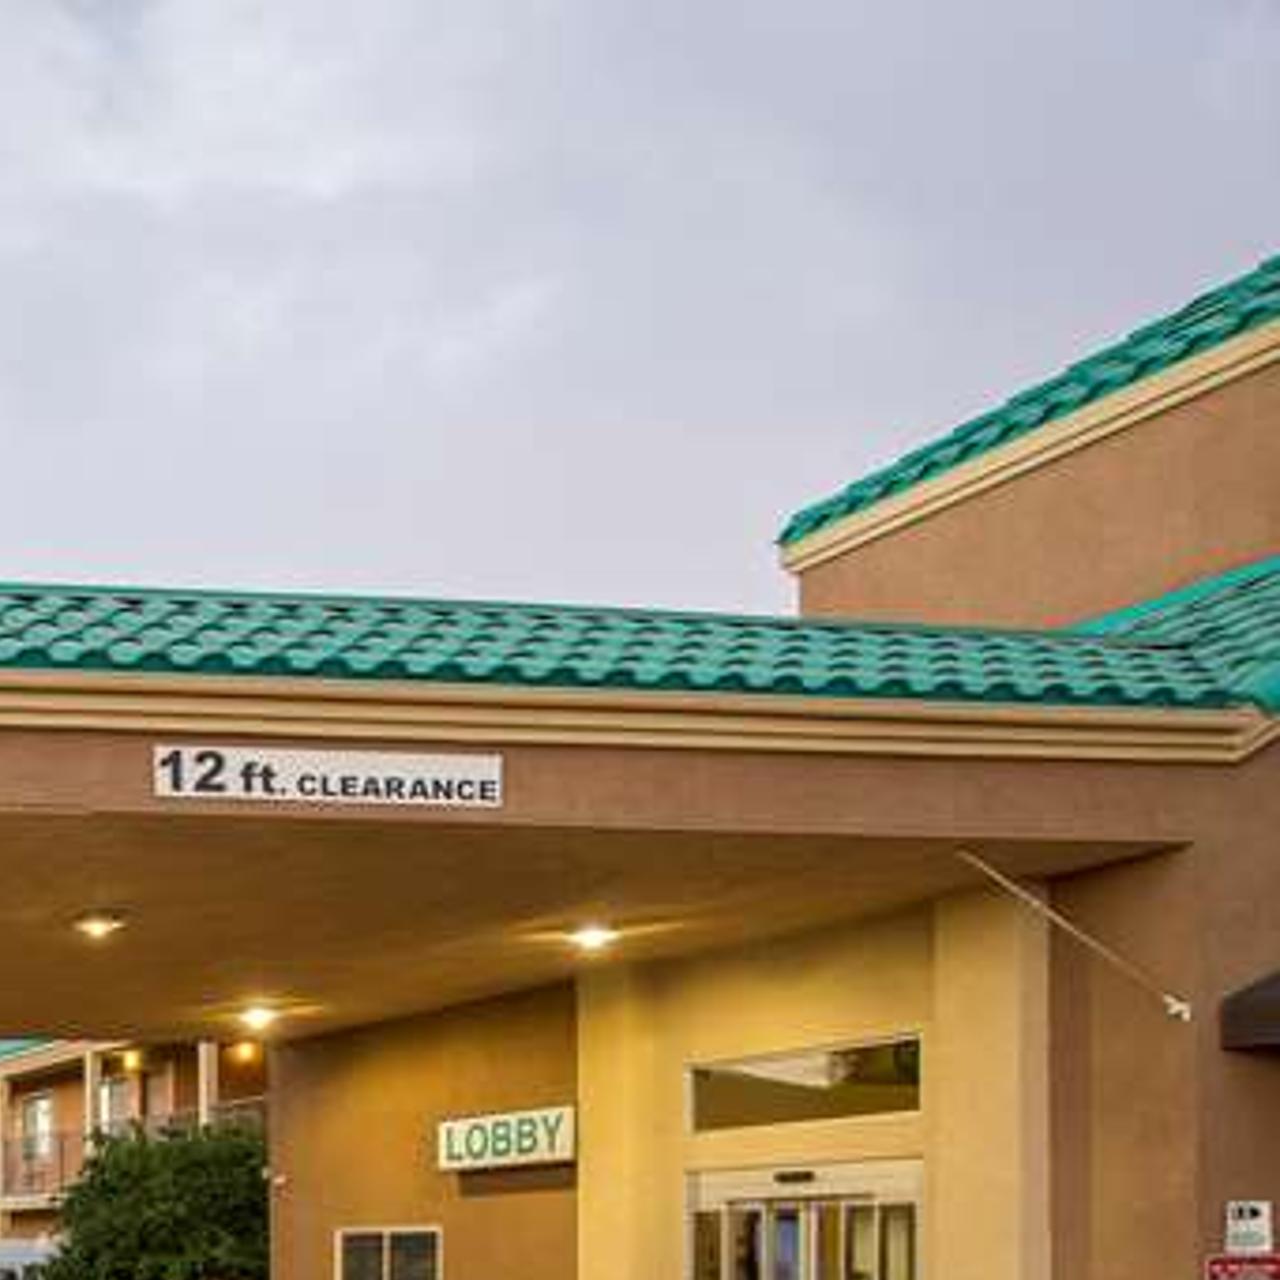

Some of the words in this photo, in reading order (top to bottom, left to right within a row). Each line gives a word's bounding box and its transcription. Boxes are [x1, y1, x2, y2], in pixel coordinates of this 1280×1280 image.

[159, 750, 226, 793] 12
[240, 761, 287, 795] ft.
[297, 774, 497, 802] CLEARANCE
[446, 1111, 564, 1161] LOBBY
